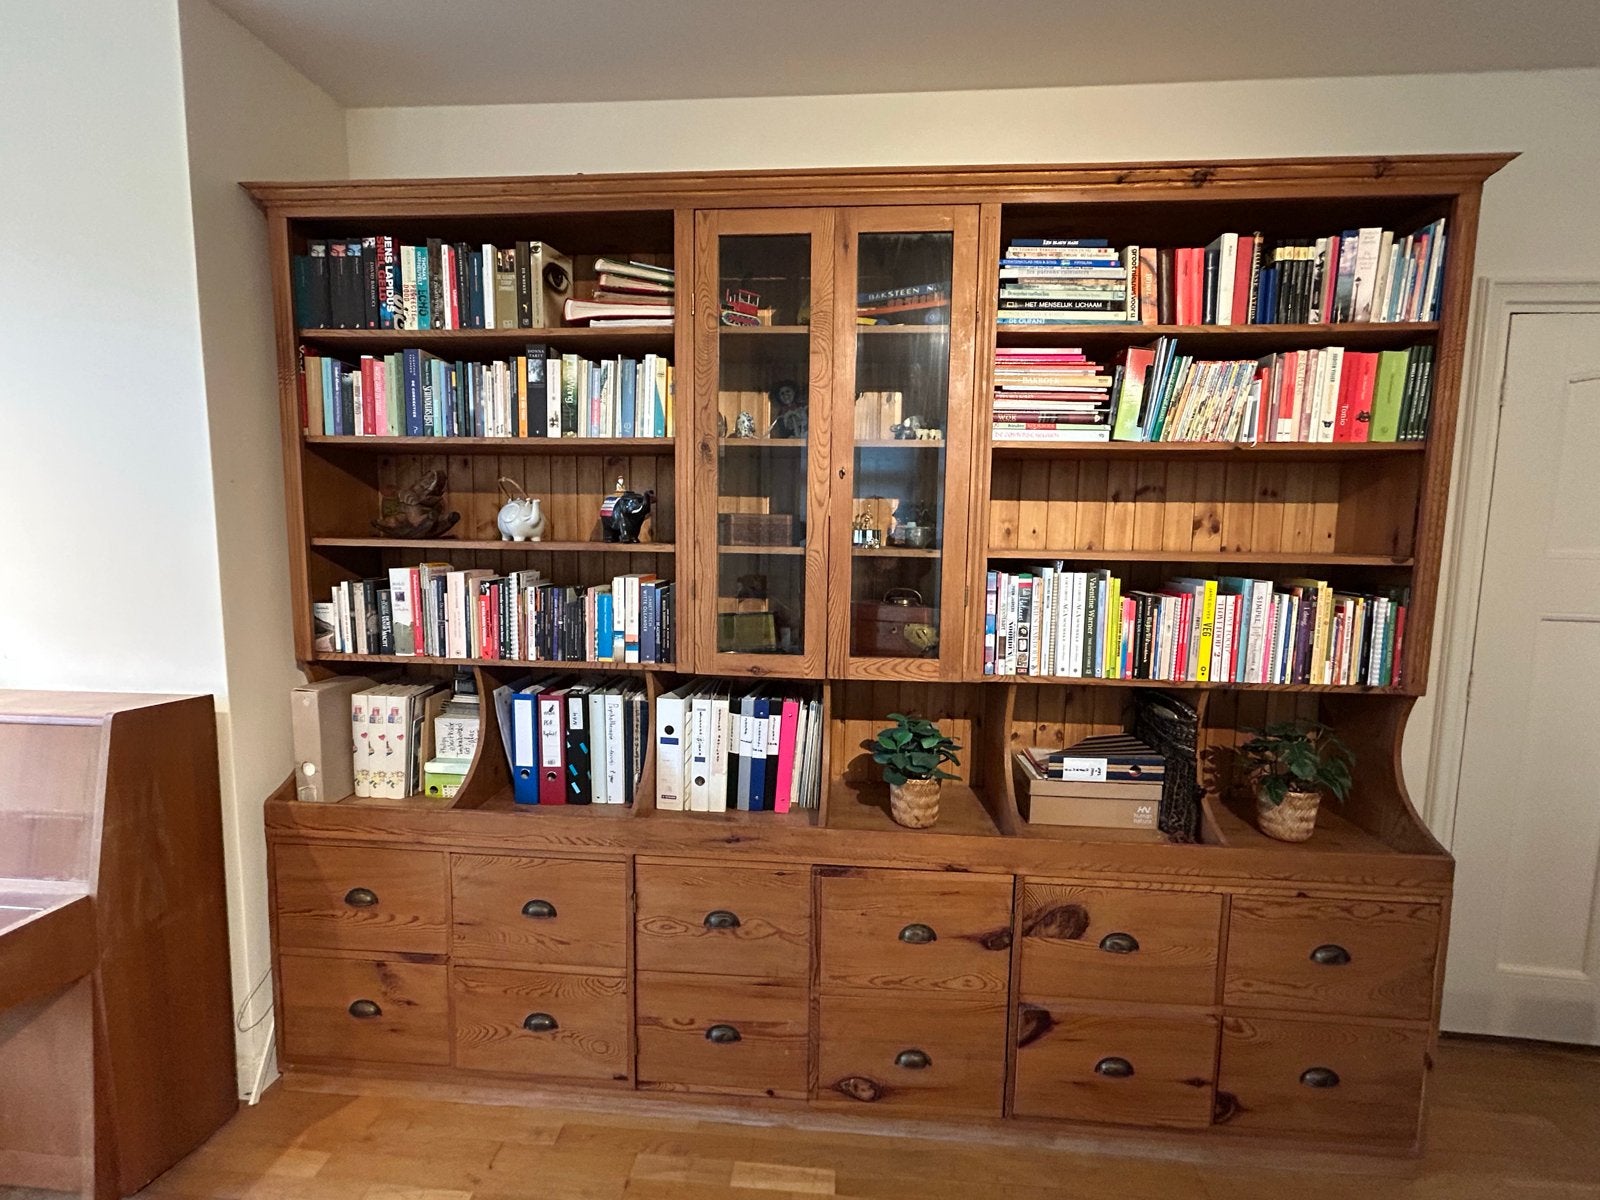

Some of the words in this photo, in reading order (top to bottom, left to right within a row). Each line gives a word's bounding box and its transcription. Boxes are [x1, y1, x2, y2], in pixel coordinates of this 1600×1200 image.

[376, 236, 384, 267] SNEL
[384, 236, 393, 263] JENS
[378, 270, 386, 301] GELD
[386, 266, 395, 312] LAPIDUS
[868, 288, 920, 300] BAKSTEEN
[419, 290, 428, 316] ECHO
[565, 380, 575, 404] Wang
[1340, 404, 1348, 426] Tonio
[1088, 577, 1097, 608] Valentine
[1087, 610, 1095, 635] Warner
[1254, 595, 1264, 625] SIMPEL
[1202, 623, 1212, 637] VEG
